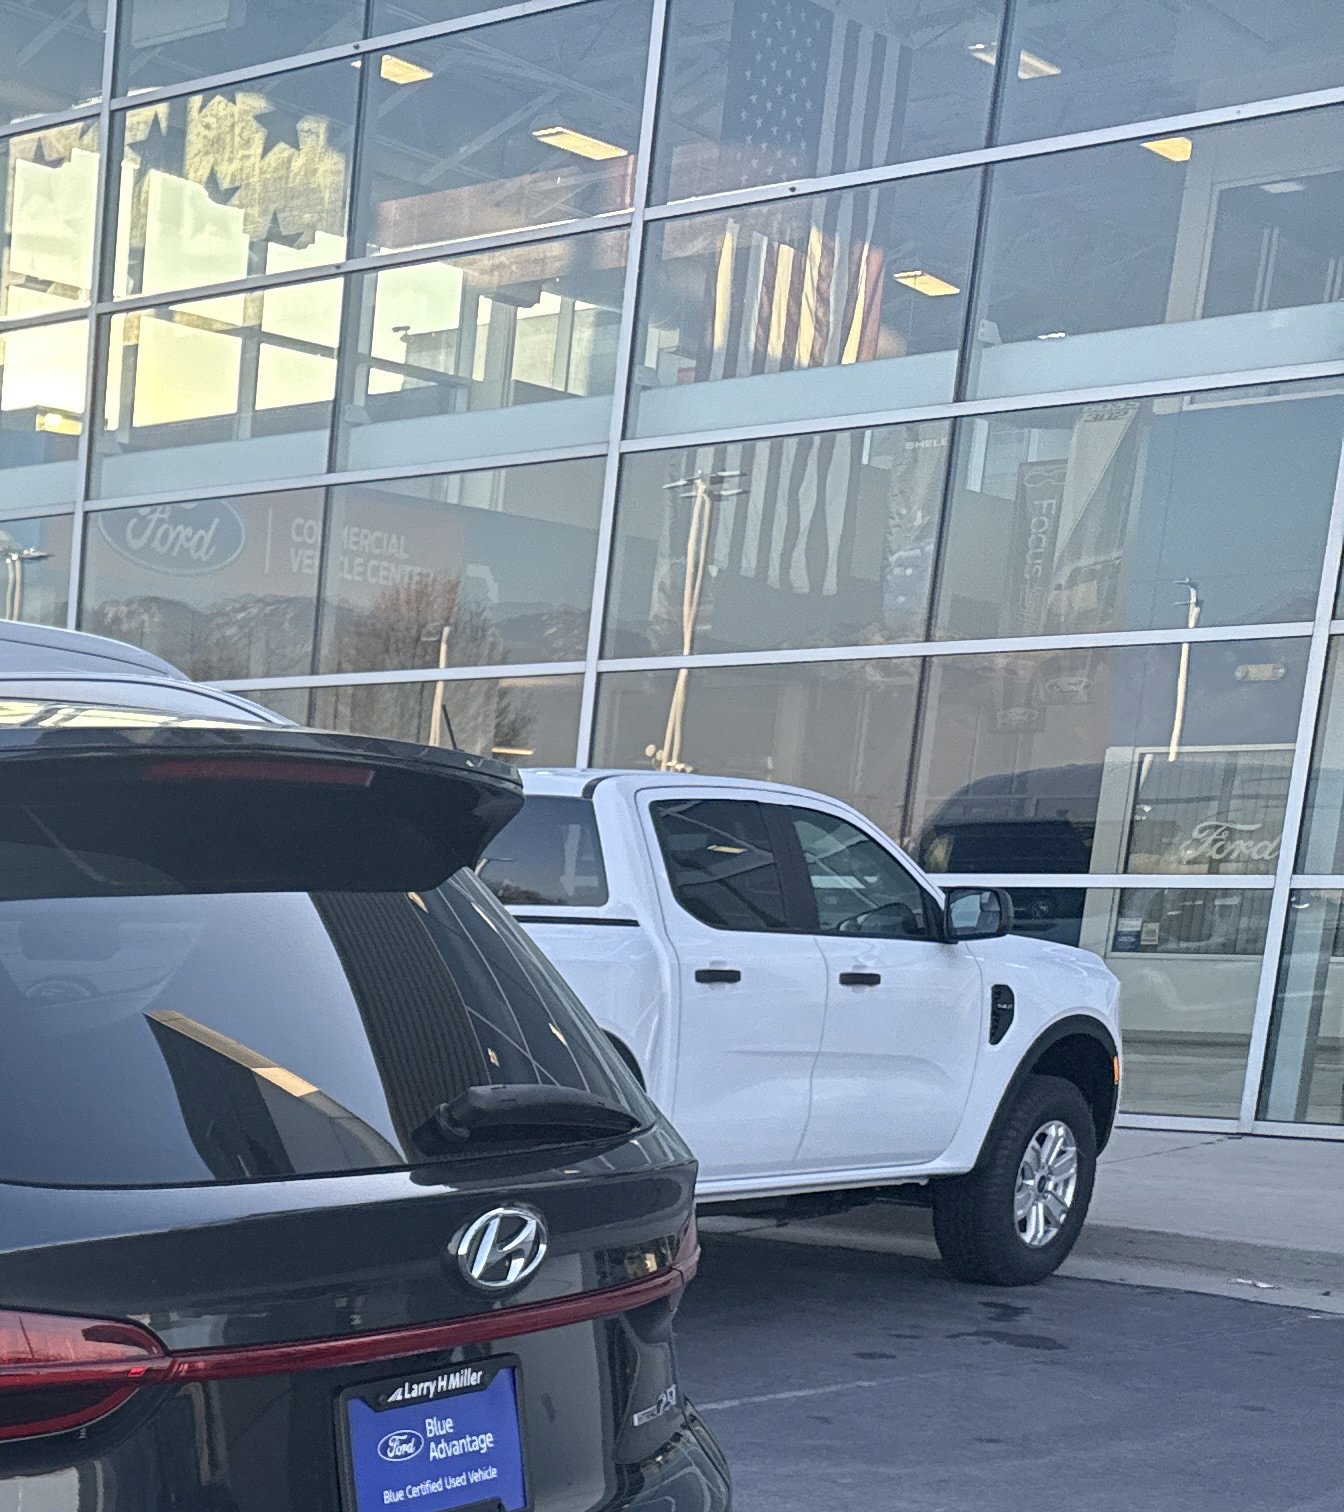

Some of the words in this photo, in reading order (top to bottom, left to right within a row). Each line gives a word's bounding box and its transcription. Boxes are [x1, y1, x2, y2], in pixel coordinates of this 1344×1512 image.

[125, 500, 221, 562] Ford
[290, 517, 408, 558] COERCIAL
[1179, 821, 1281, 864] Ford
[404, 1380, 437, 1399] Larry
[437, 1374, 448, 1392] H
[448, 1368, 483, 1390] Miller
[386, 1435, 416, 1457] Ford
[429, 1432, 495, 1461] Advantage
[425, 1417, 454, 1438] Blue
[383, 1489, 404, 1504] Blue
[406, 1480, 443, 1498] Certified
[444, 1472, 467, 1490] Used
[468, 1465, 498, 1483] Vehicle
